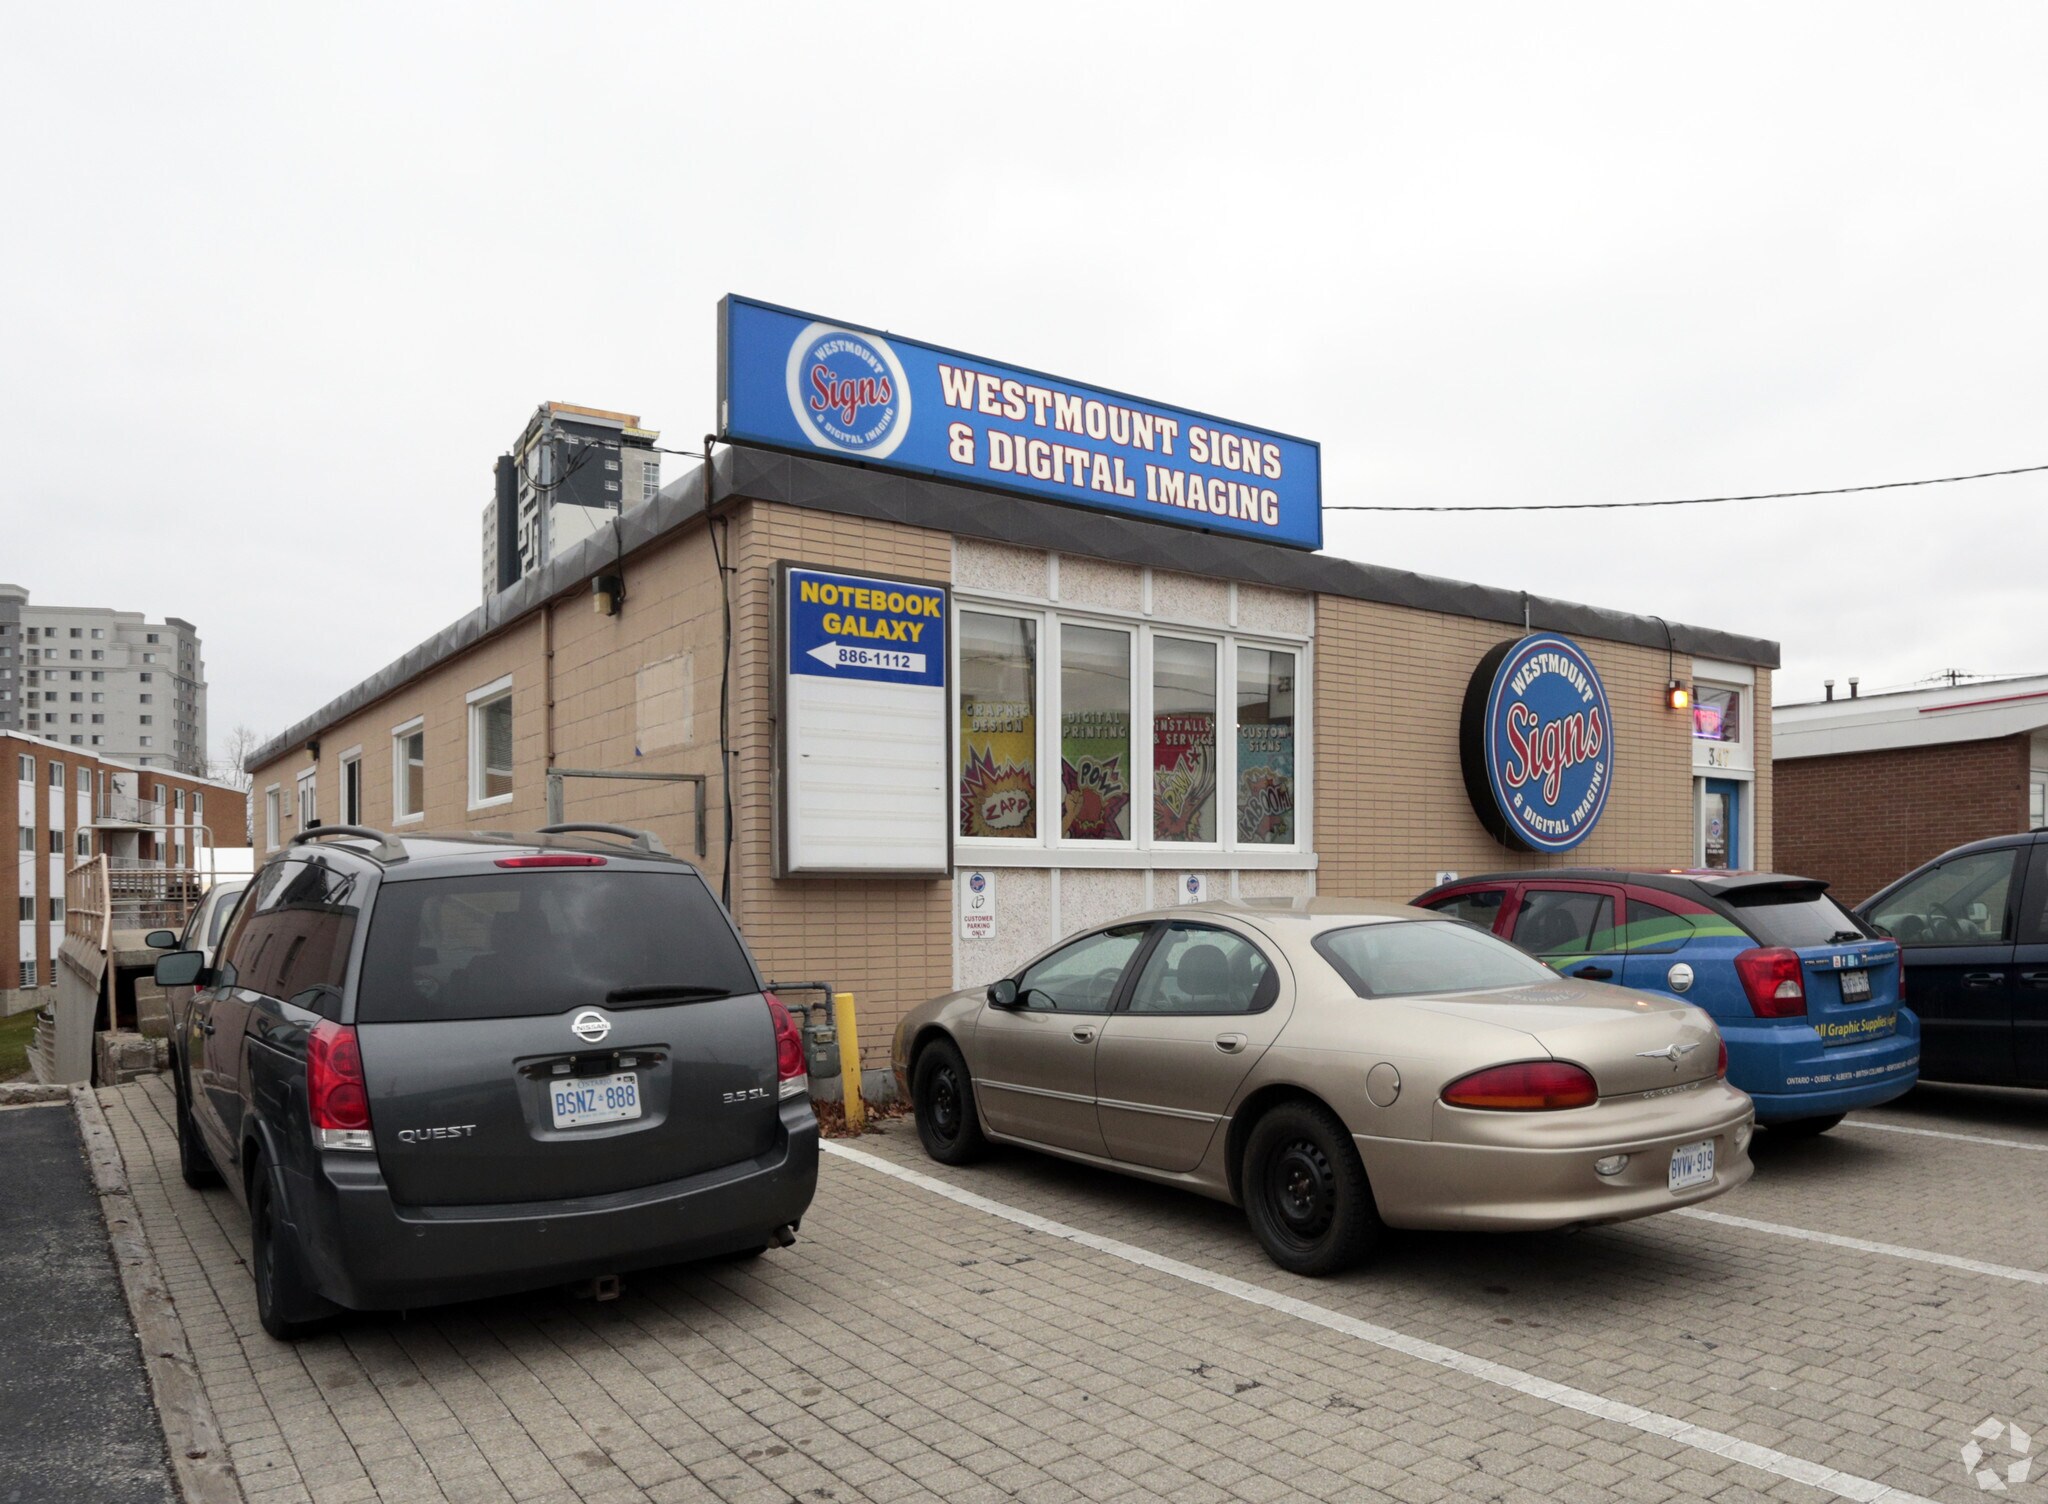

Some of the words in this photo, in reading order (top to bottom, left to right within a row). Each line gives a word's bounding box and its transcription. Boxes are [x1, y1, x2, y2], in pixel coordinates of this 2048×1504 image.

[814, 340, 884, 374] WESTMOUNT
[810, 364, 892, 427] Signs
[824, 422, 863, 443] DIGITAL
[865, 407, 894, 442] IMAGING
[938, 364, 1178, 456] WESTMOUNT
[1188, 425, 1282, 480] SIGNS
[948, 422, 975, 466] &
[987, 429, 1136, 498] DIGITAL
[1145, 463, 1279, 526] IMAGING
[801, 580, 941, 618] NOTEBOOK
[822, 612, 925, 643] GALAXY
[838, 649, 910, 668] 886-1112
[1511, 653, 1593, 703] WESTMOUNT
[1241, 726, 1288, 739] CUSTOM
[1505, 702, 1603, 806] Signs
[1081, 761, 1122, 796] POW
[1513, 792, 1523, 808] &
[1523, 805, 1569, 835] DIGITAL
[1571, 761, 1604, 826] IMAGING
[576, 1023, 608, 1032] NISSAN
[1814, 1023, 1826, 1037] All
[1827, 1020, 1860, 1037] Graphic
[1861, 1015, 1887, 1033] Supplies
[577, 1078, 612, 1088] ONTARIO
[1786, 1076, 1810, 1085] ONTARIO
[555, 1089, 596, 1116] BSNZ
[606, 1085, 635, 1109] 888
[398, 1124, 476, 1144] QUEST
